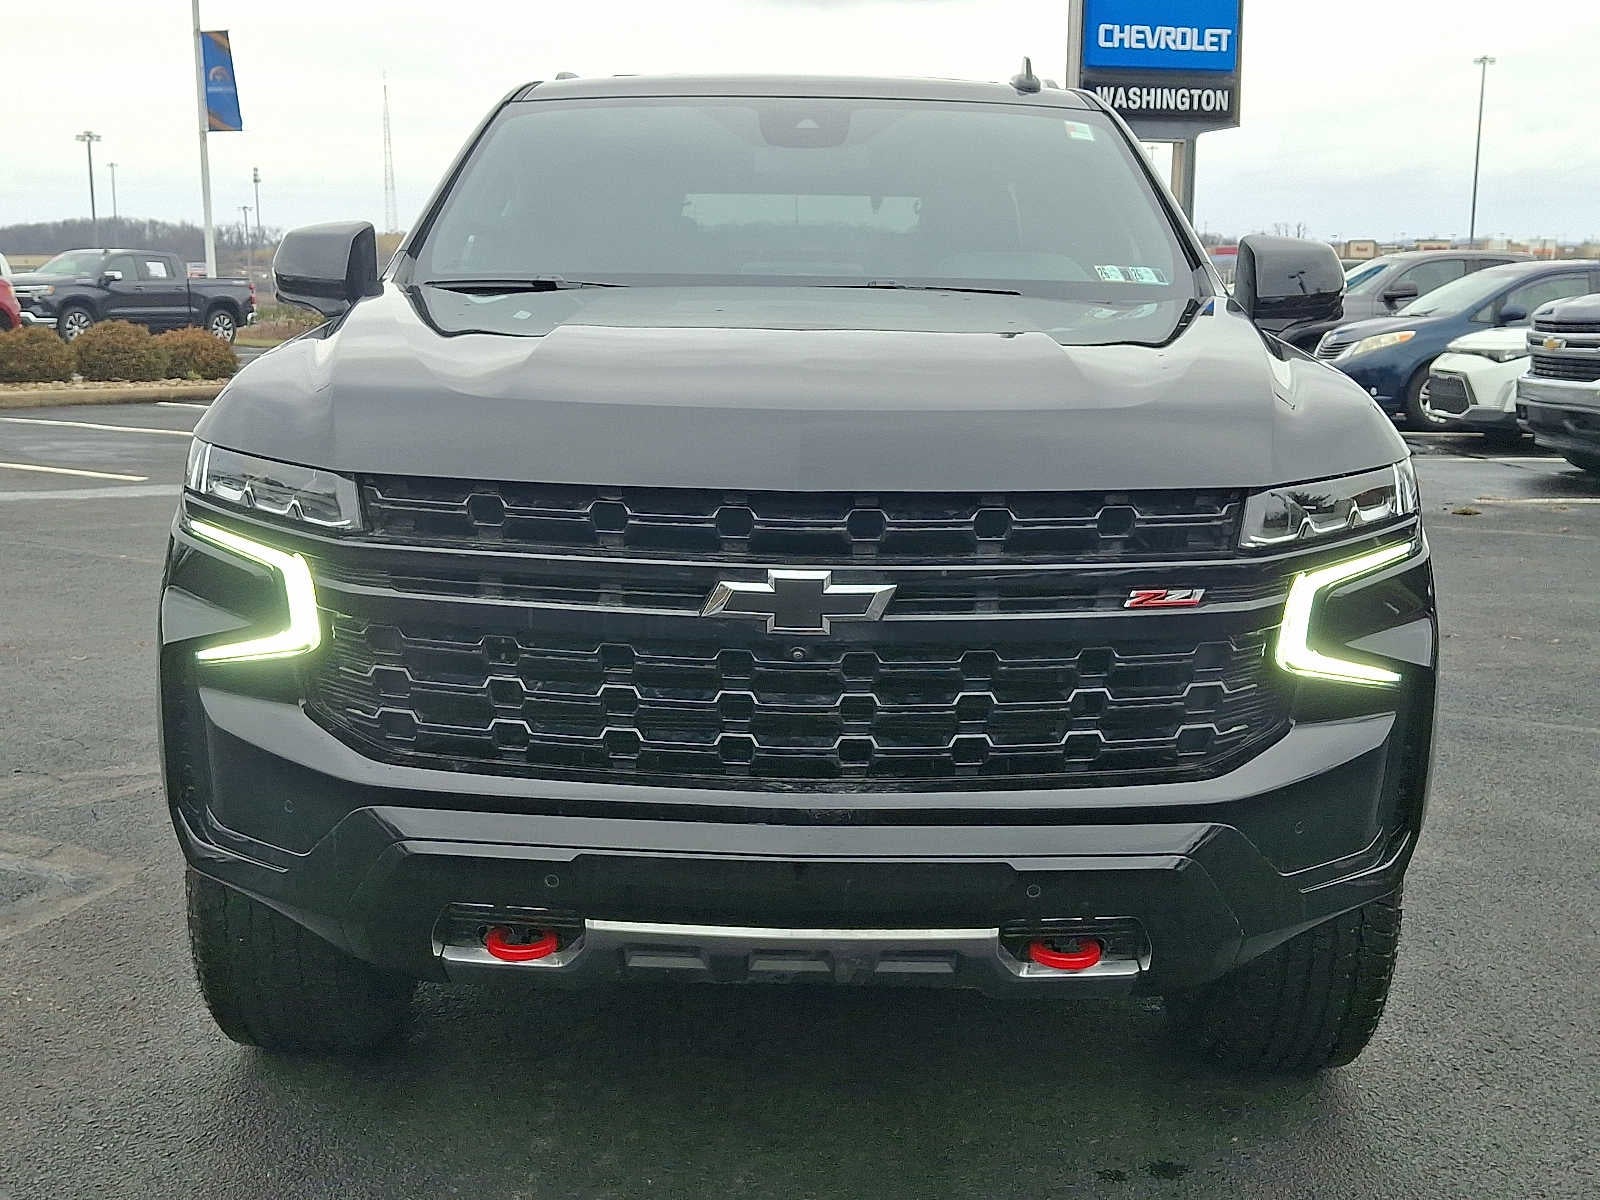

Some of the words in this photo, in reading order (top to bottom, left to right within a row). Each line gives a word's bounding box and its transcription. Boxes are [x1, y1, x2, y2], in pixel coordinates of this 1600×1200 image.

[1098, 24, 1232, 51] CHEVROLET
[1096, 86, 1229, 111] WASHINGTON
[1123, 588, 1206, 608] Z71
